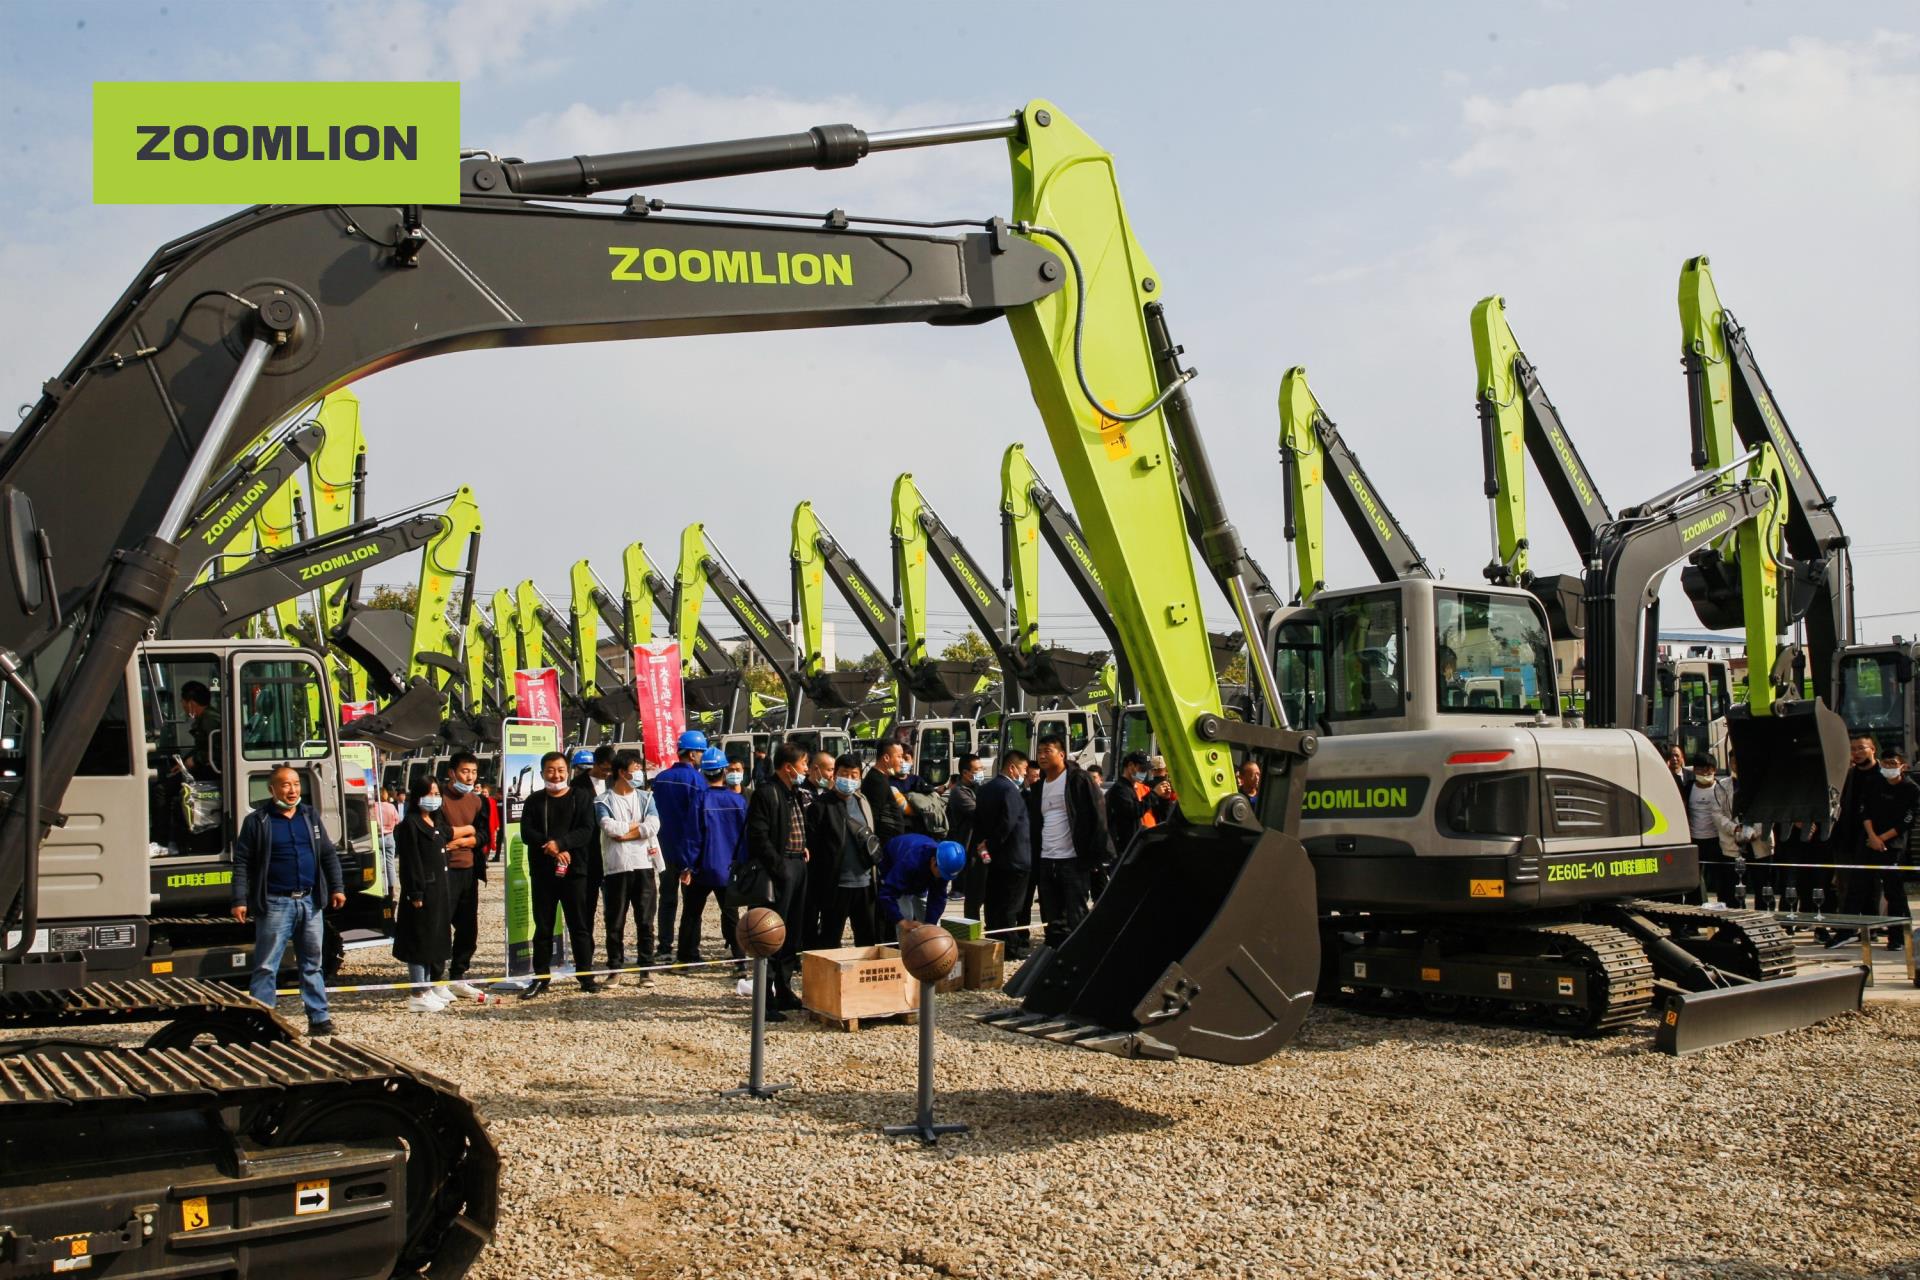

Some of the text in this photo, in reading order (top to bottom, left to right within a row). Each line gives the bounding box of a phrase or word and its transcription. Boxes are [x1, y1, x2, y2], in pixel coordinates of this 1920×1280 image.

[608, 246, 854, 287] ZOOMLION
[1758, 392, 1802, 480] ZOOMLION
[1550, 427, 1593, 506] ZOOMLION
[202, 479, 268, 545] ZOOMLION
[1347, 470, 1392, 542] ZOOMLION
[1682, 509, 1727, 542] ZOOMLION
[299, 543, 380, 580] ZOOMLION
[950, 553, 991, 607] ZOOMLION
[732, 595, 770, 639] ZOOMLION
[847, 573, 886, 623] ZOOMLION
[1547, 858, 1659, 881] ZE60E-10 中联重科
